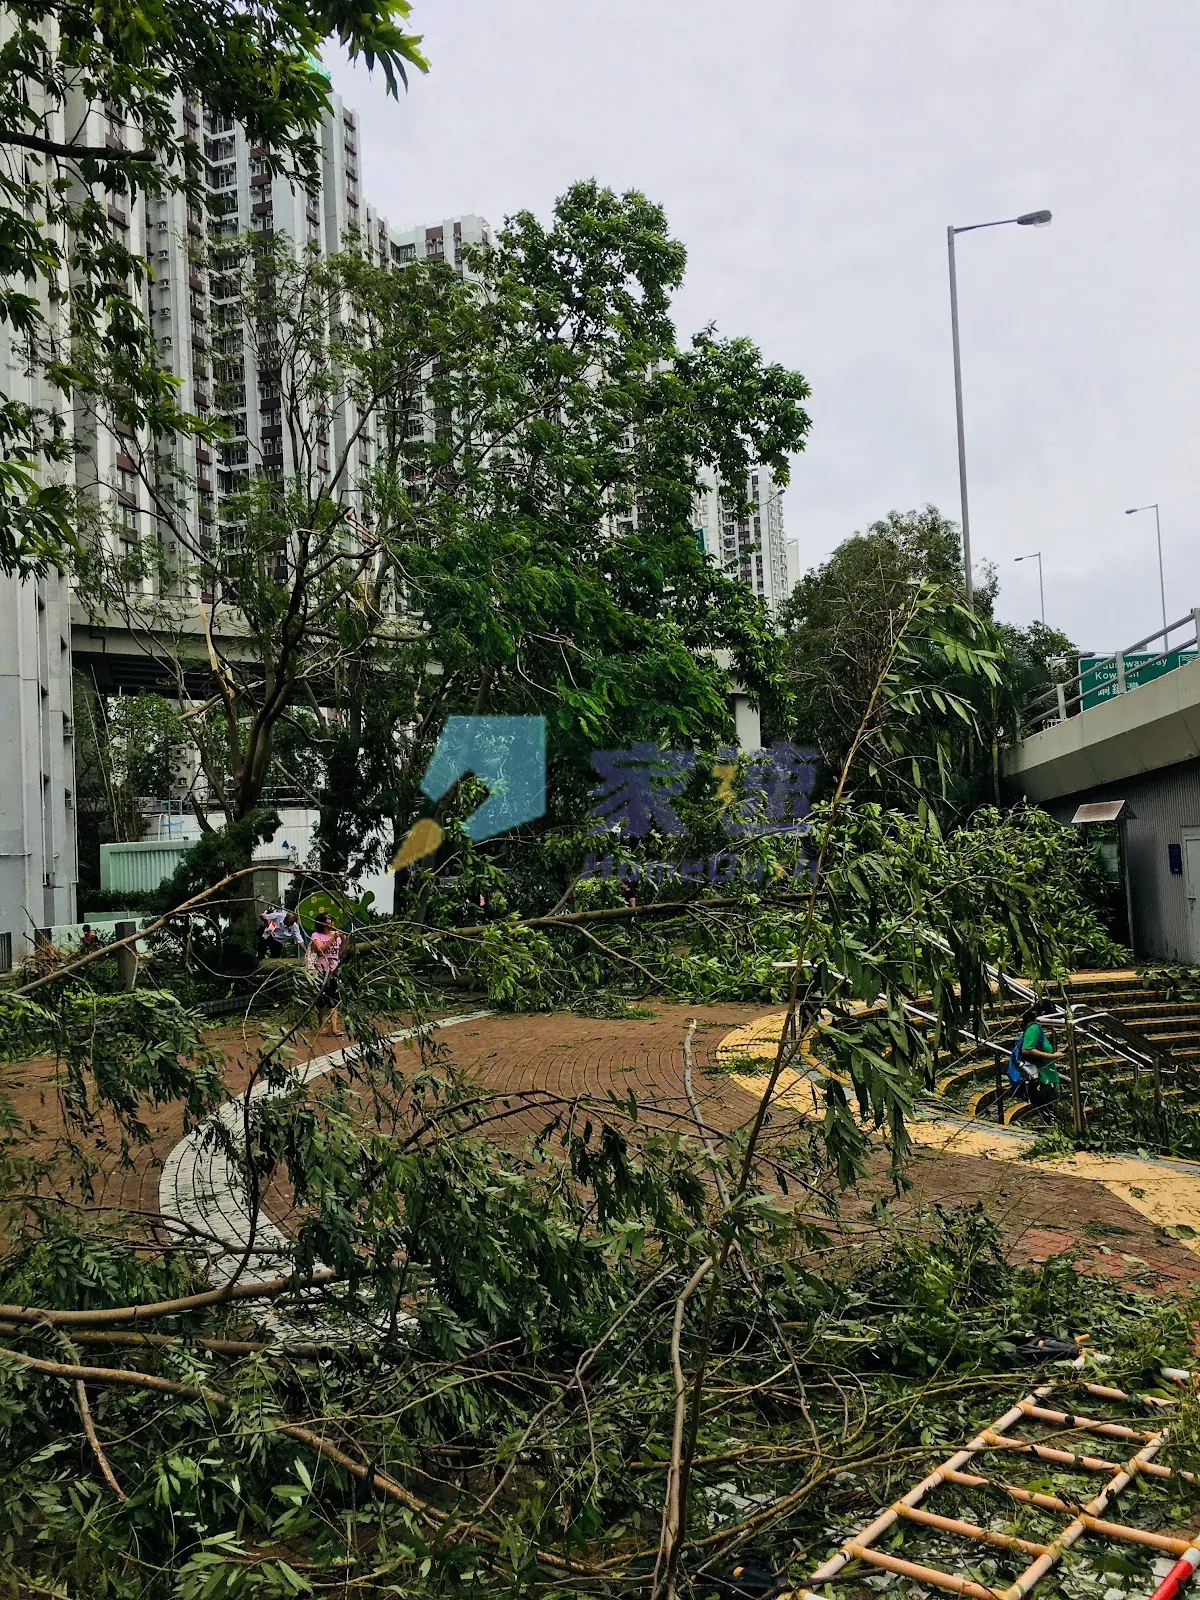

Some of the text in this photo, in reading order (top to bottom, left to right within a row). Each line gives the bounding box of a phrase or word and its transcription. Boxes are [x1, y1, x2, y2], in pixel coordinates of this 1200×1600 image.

[1095, 657, 1168, 669] Causway ay
[1095, 671, 1139, 680] Kown
